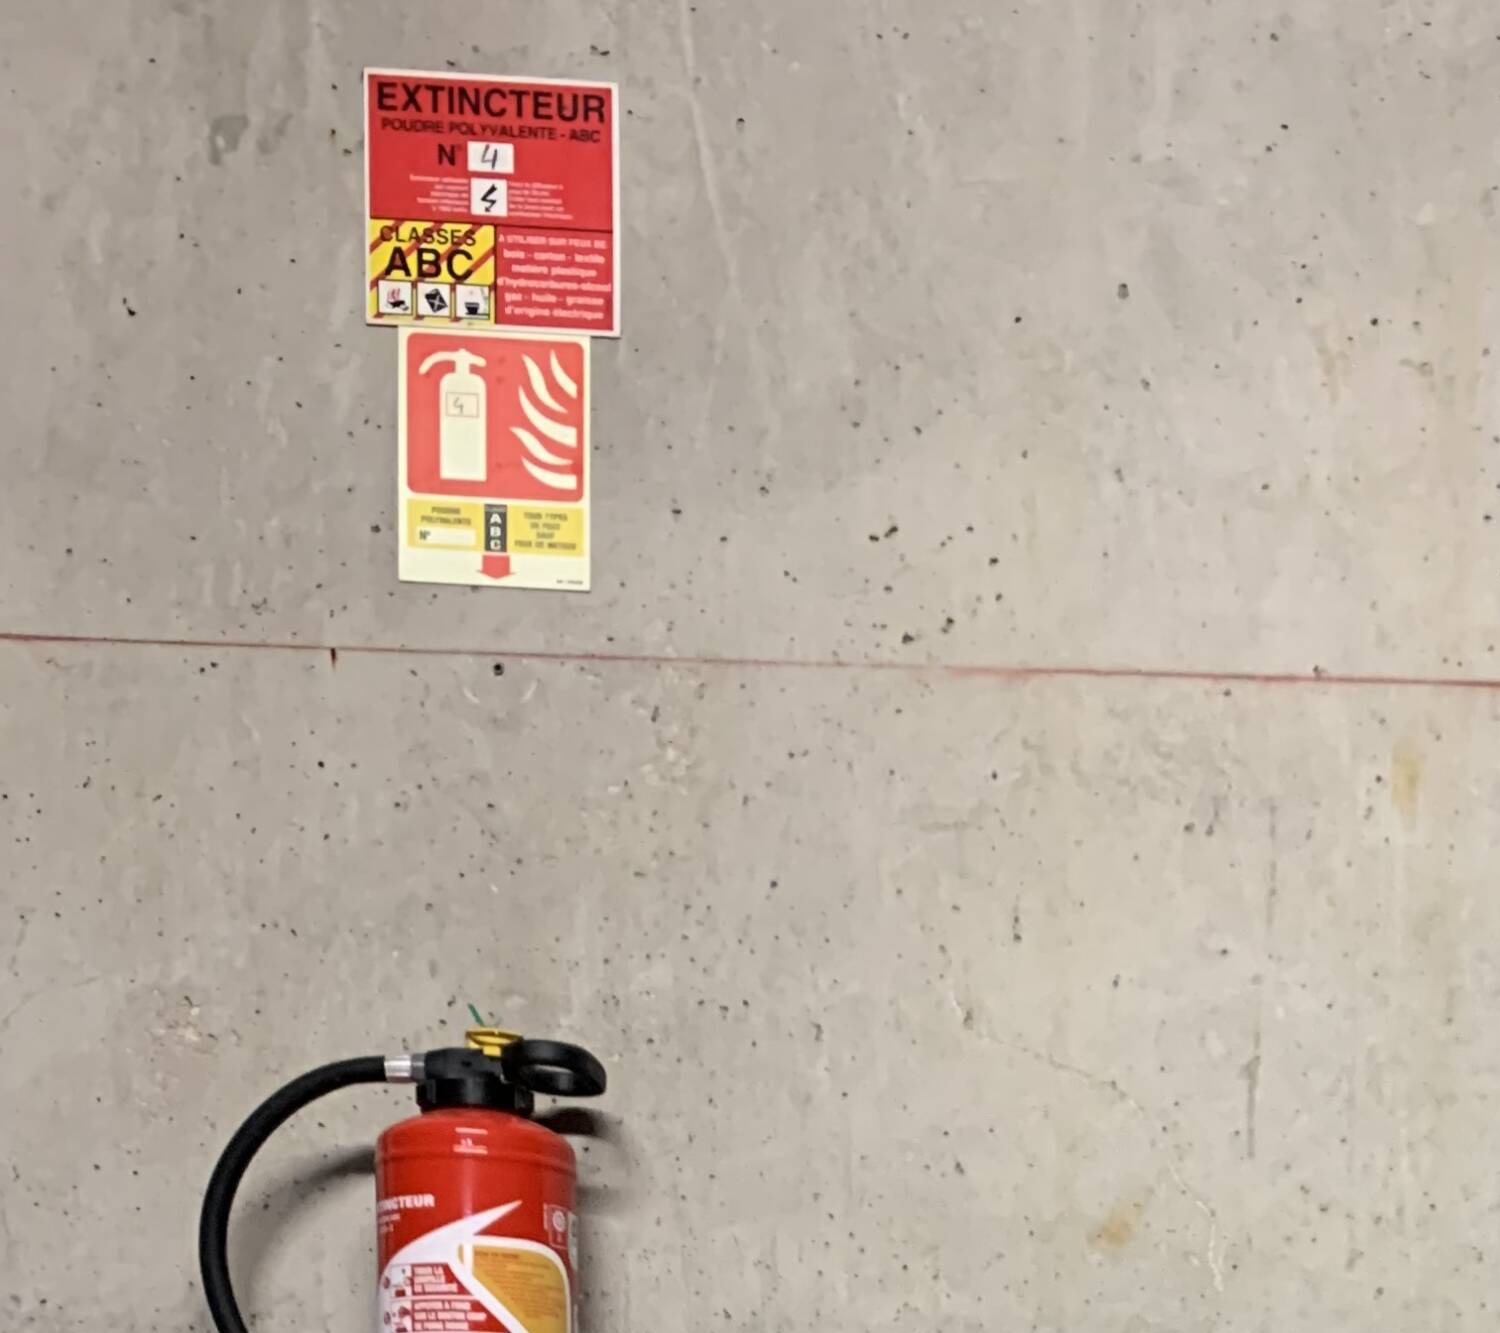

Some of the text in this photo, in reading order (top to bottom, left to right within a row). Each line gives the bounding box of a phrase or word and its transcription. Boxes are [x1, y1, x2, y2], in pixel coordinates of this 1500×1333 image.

[377, 81, 606, 123] EXTINCTEUR
[381, 117, 444, 134] POUDRE
[449, 121, 557, 140] POLYVALENTE
[569, 128, 601, 143] ABC
[481, 143, 499, 170] 4
[380, 225, 477, 246] CLASSES
[385, 246, 474, 281] ABC
[490, 513, 502, 524] A
